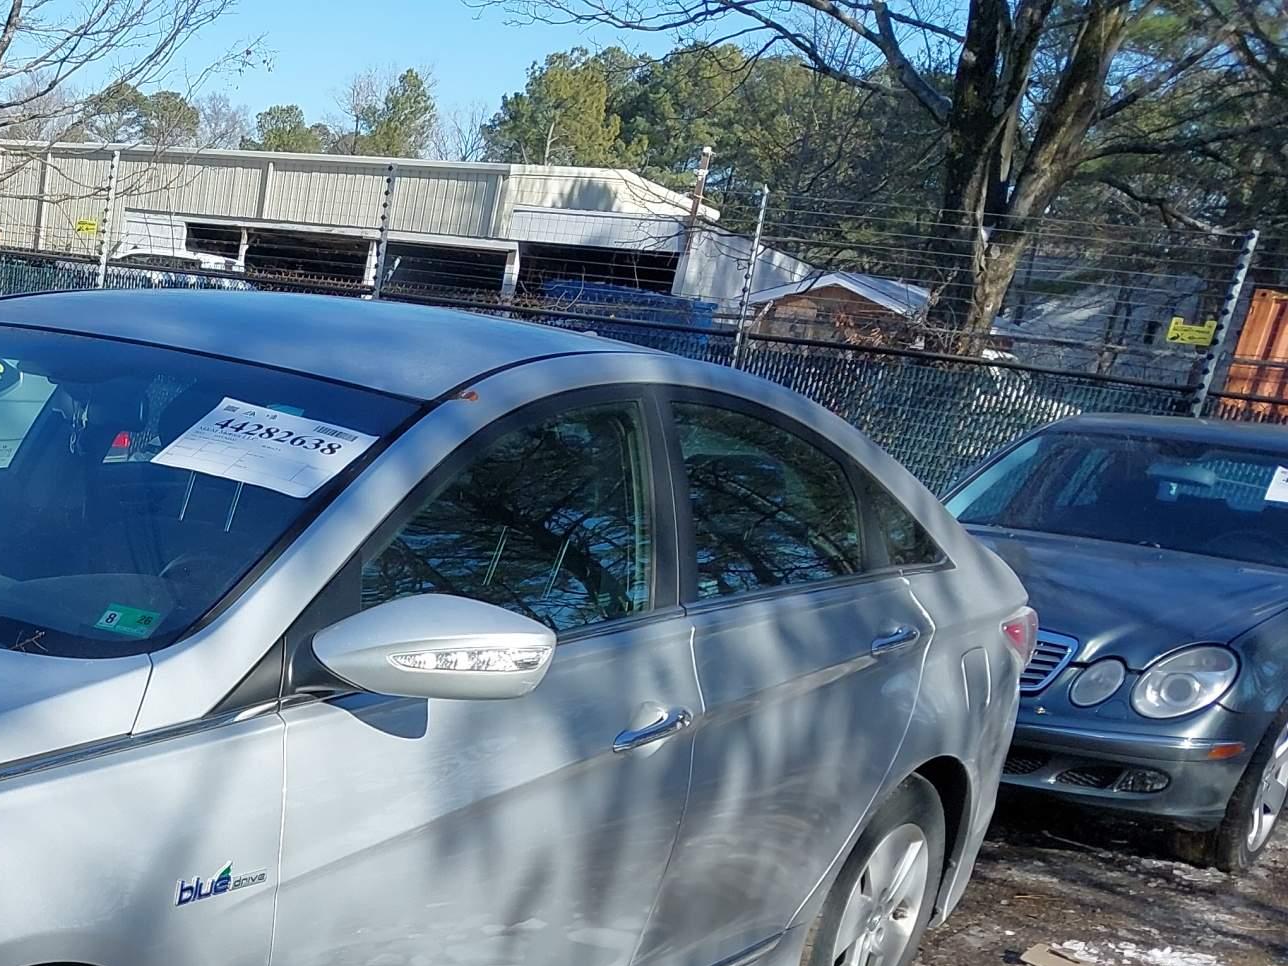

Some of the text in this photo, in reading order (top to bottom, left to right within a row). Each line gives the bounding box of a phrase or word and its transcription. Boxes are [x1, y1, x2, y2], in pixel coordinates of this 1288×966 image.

[215, 418, 342, 455] 44282638
[105, 612, 153, 625] 8 26
[175, 867, 266, 906] blue drive
